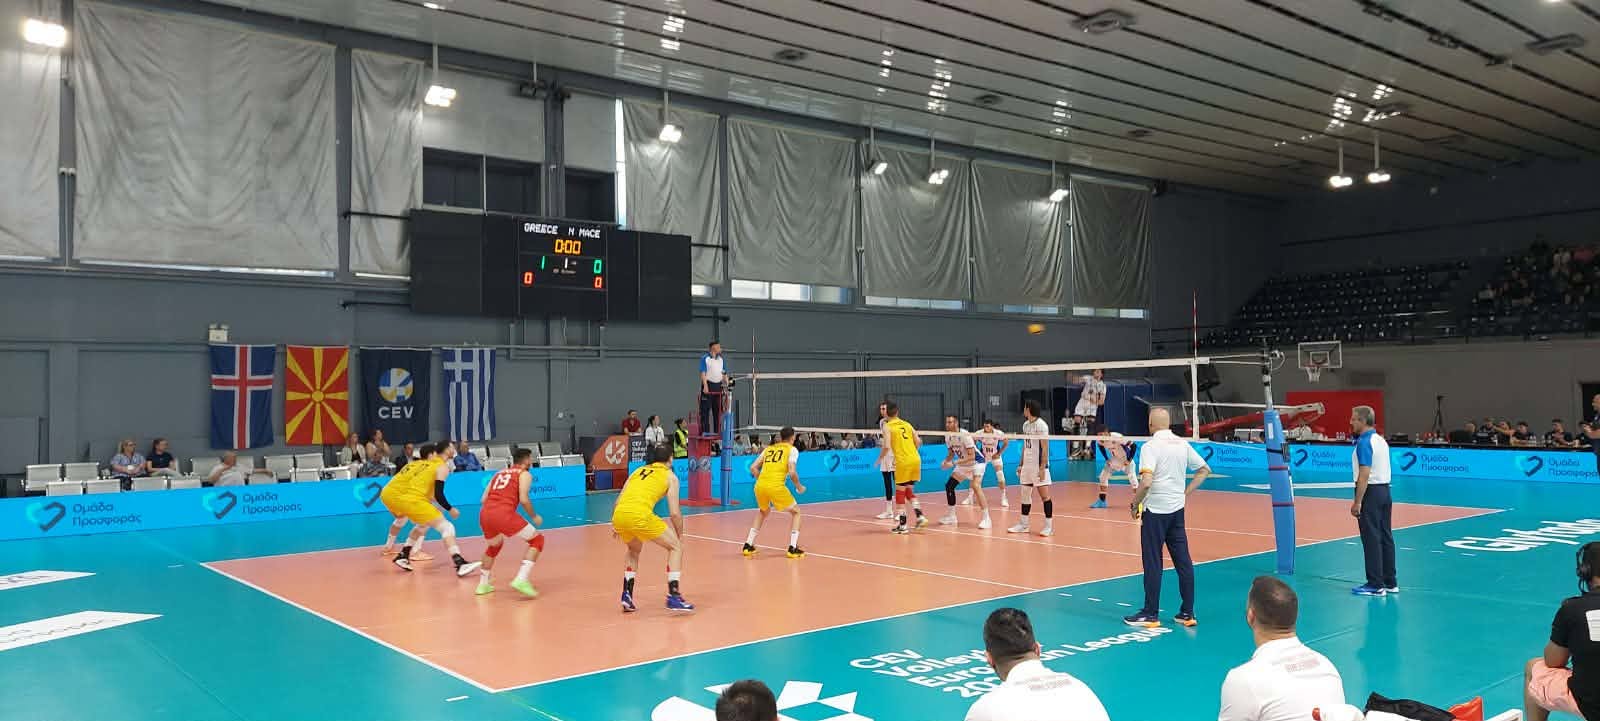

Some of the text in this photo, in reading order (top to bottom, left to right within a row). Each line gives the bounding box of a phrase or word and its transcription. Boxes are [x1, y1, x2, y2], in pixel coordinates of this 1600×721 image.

[524, 222, 559, 234] GREECE
[578, 228, 601, 239] MACE
[593, 259, 603, 274] 0
[523, 271, 534, 285] 0
[594, 276, 603, 289] 0
[378, 405, 414, 419] CEV
[900, 427, 909, 440] 2
[765, 450, 783, 463] 20
[639, 469, 654, 480] 4
[73, 502, 114, 514] Ομάδα
[1060, 628, 1173, 652] League
[850, 649, 922, 669] CEV
[872, 649, 988, 677] Volley
